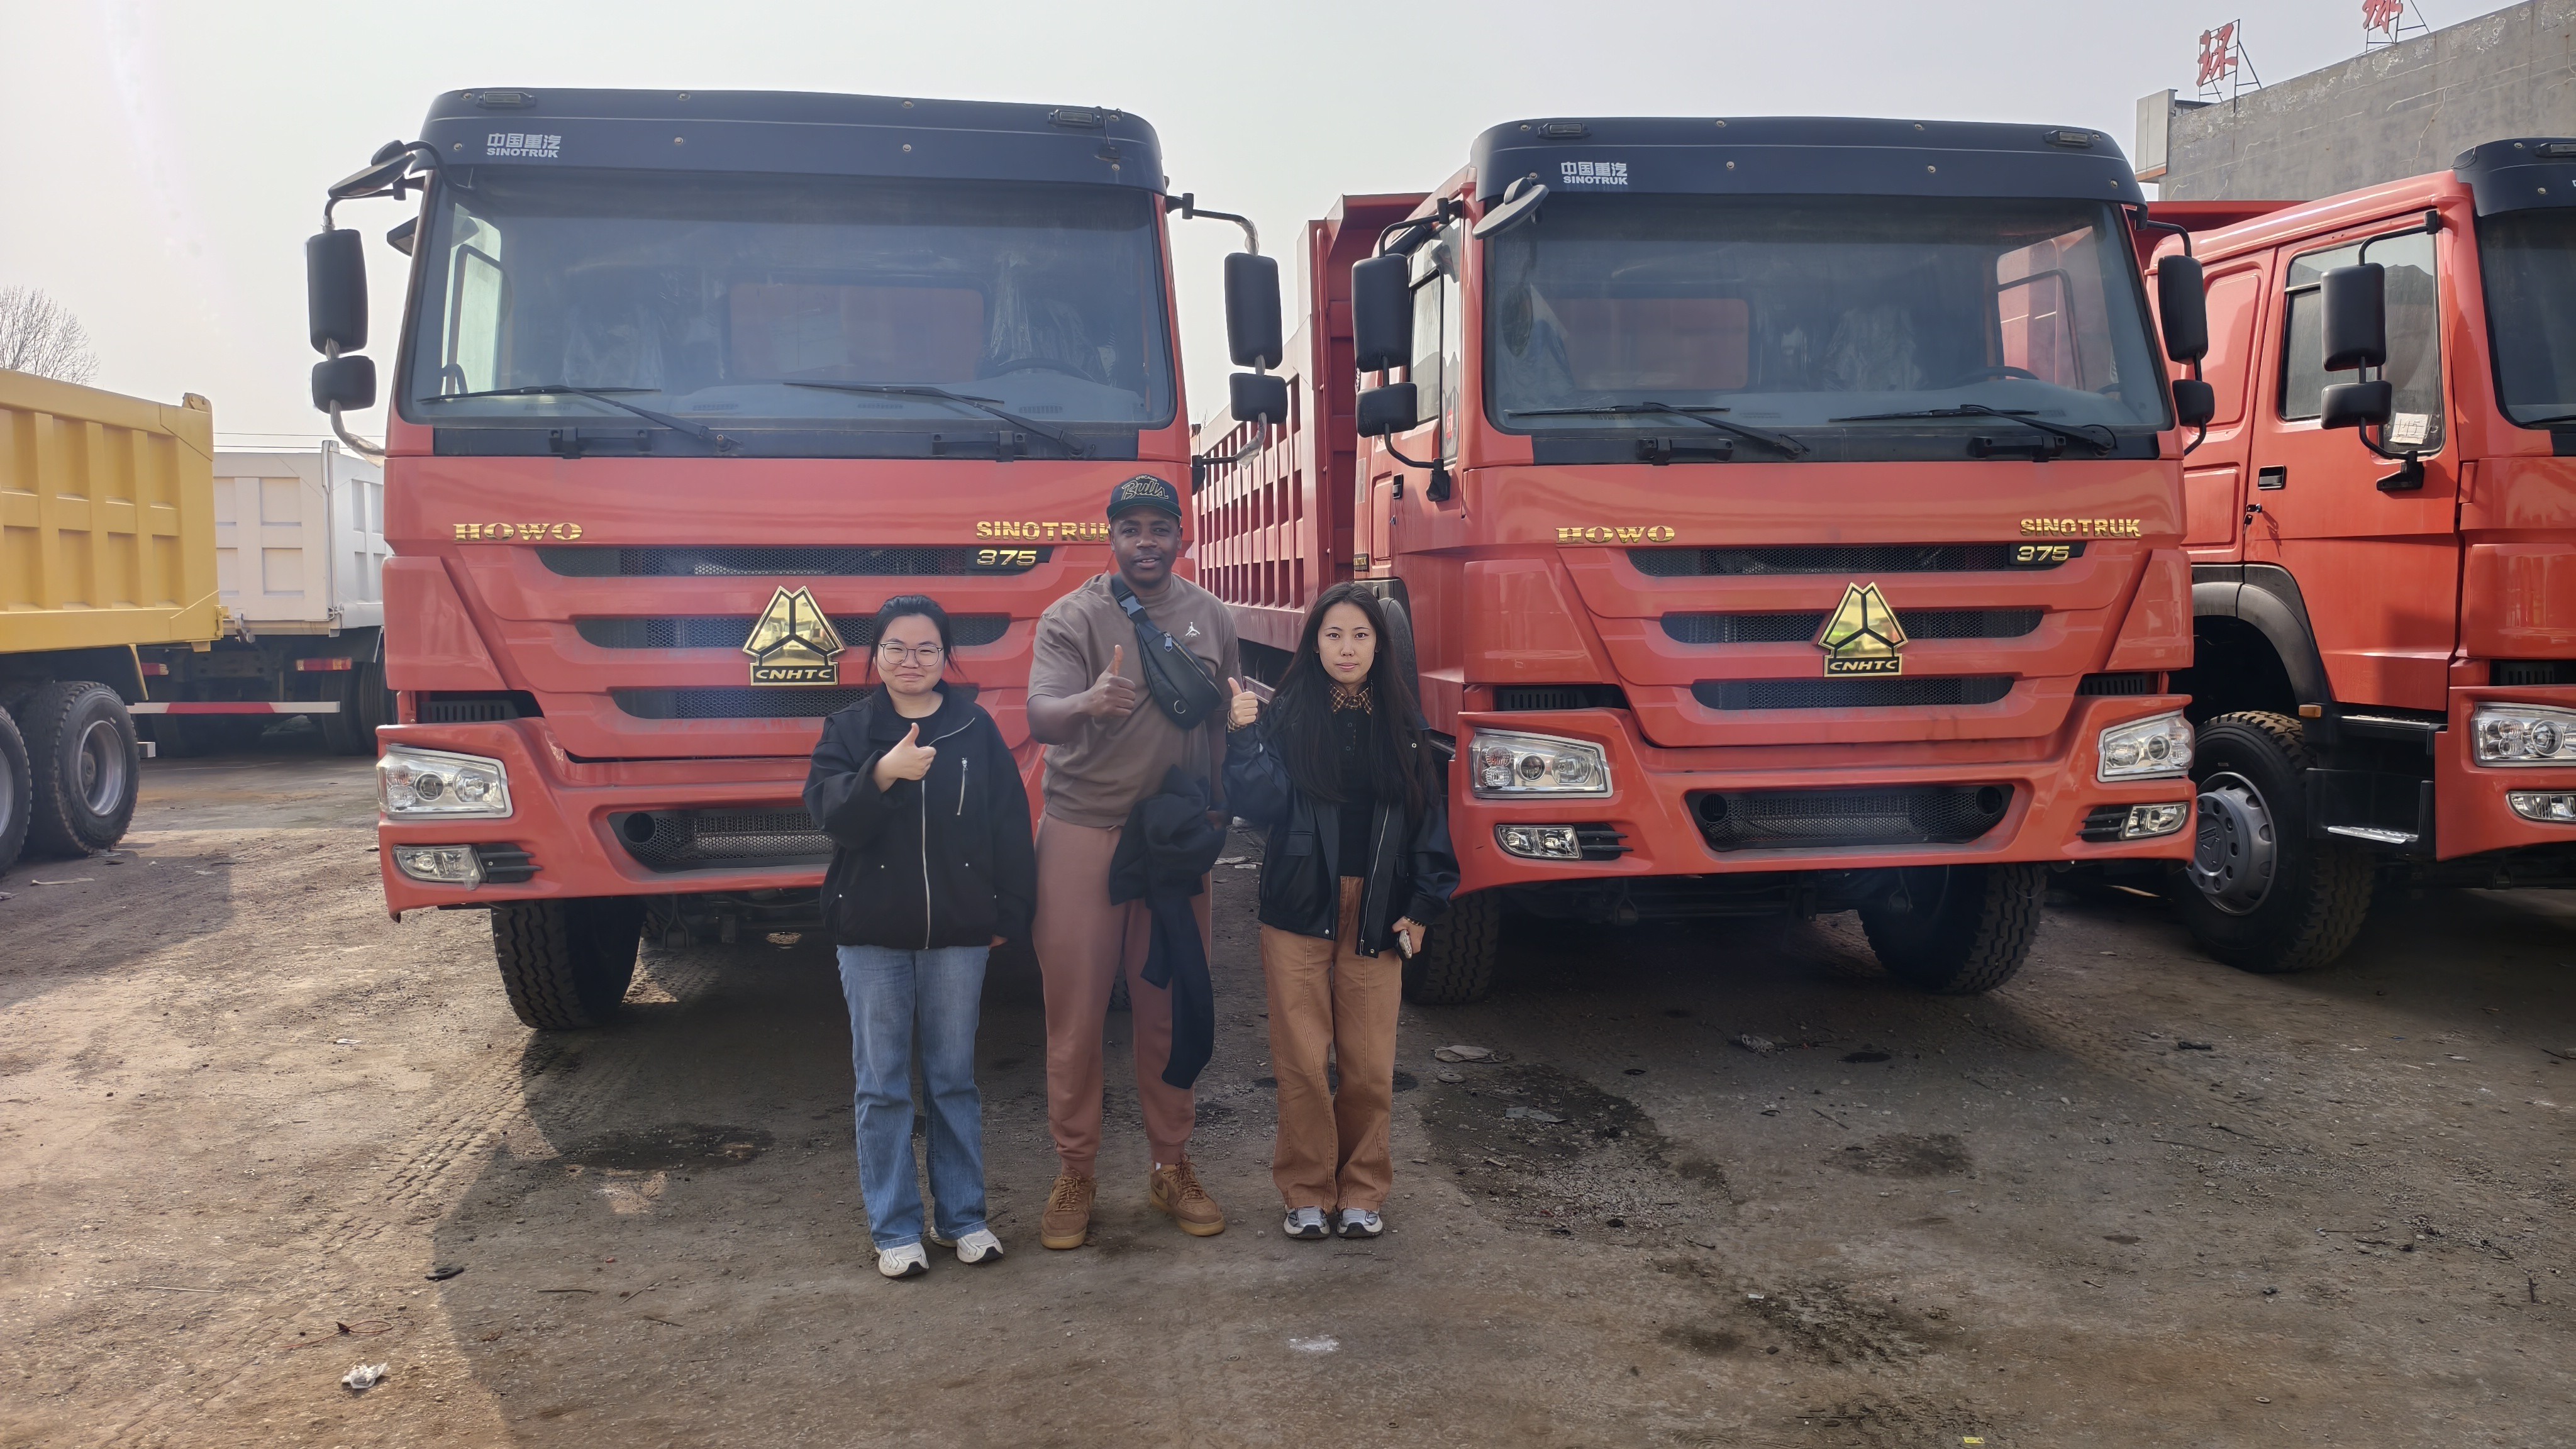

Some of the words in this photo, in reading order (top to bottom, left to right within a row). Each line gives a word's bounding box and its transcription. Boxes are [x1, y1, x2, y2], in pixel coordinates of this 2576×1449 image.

[487, 133, 561, 149] 中国重汽
[487, 148, 558, 158] SINOTRUK
[1561, 162, 1628, 177] 中国重汽
[1563, 176, 1628, 185] SINOTRUK
[1121, 480, 1169, 501] Bulls
[453, 523, 583, 541] HOWO
[1555, 526, 1675, 544] HOWO
[2020, 518, 2141, 538] SINOTRUK
[977, 549, 1037, 566] 375
[2016, 545, 2070, 561] 375
[1829, 660, 1897, 670] CNHTC
[756, 669, 833, 679] CNHTC
